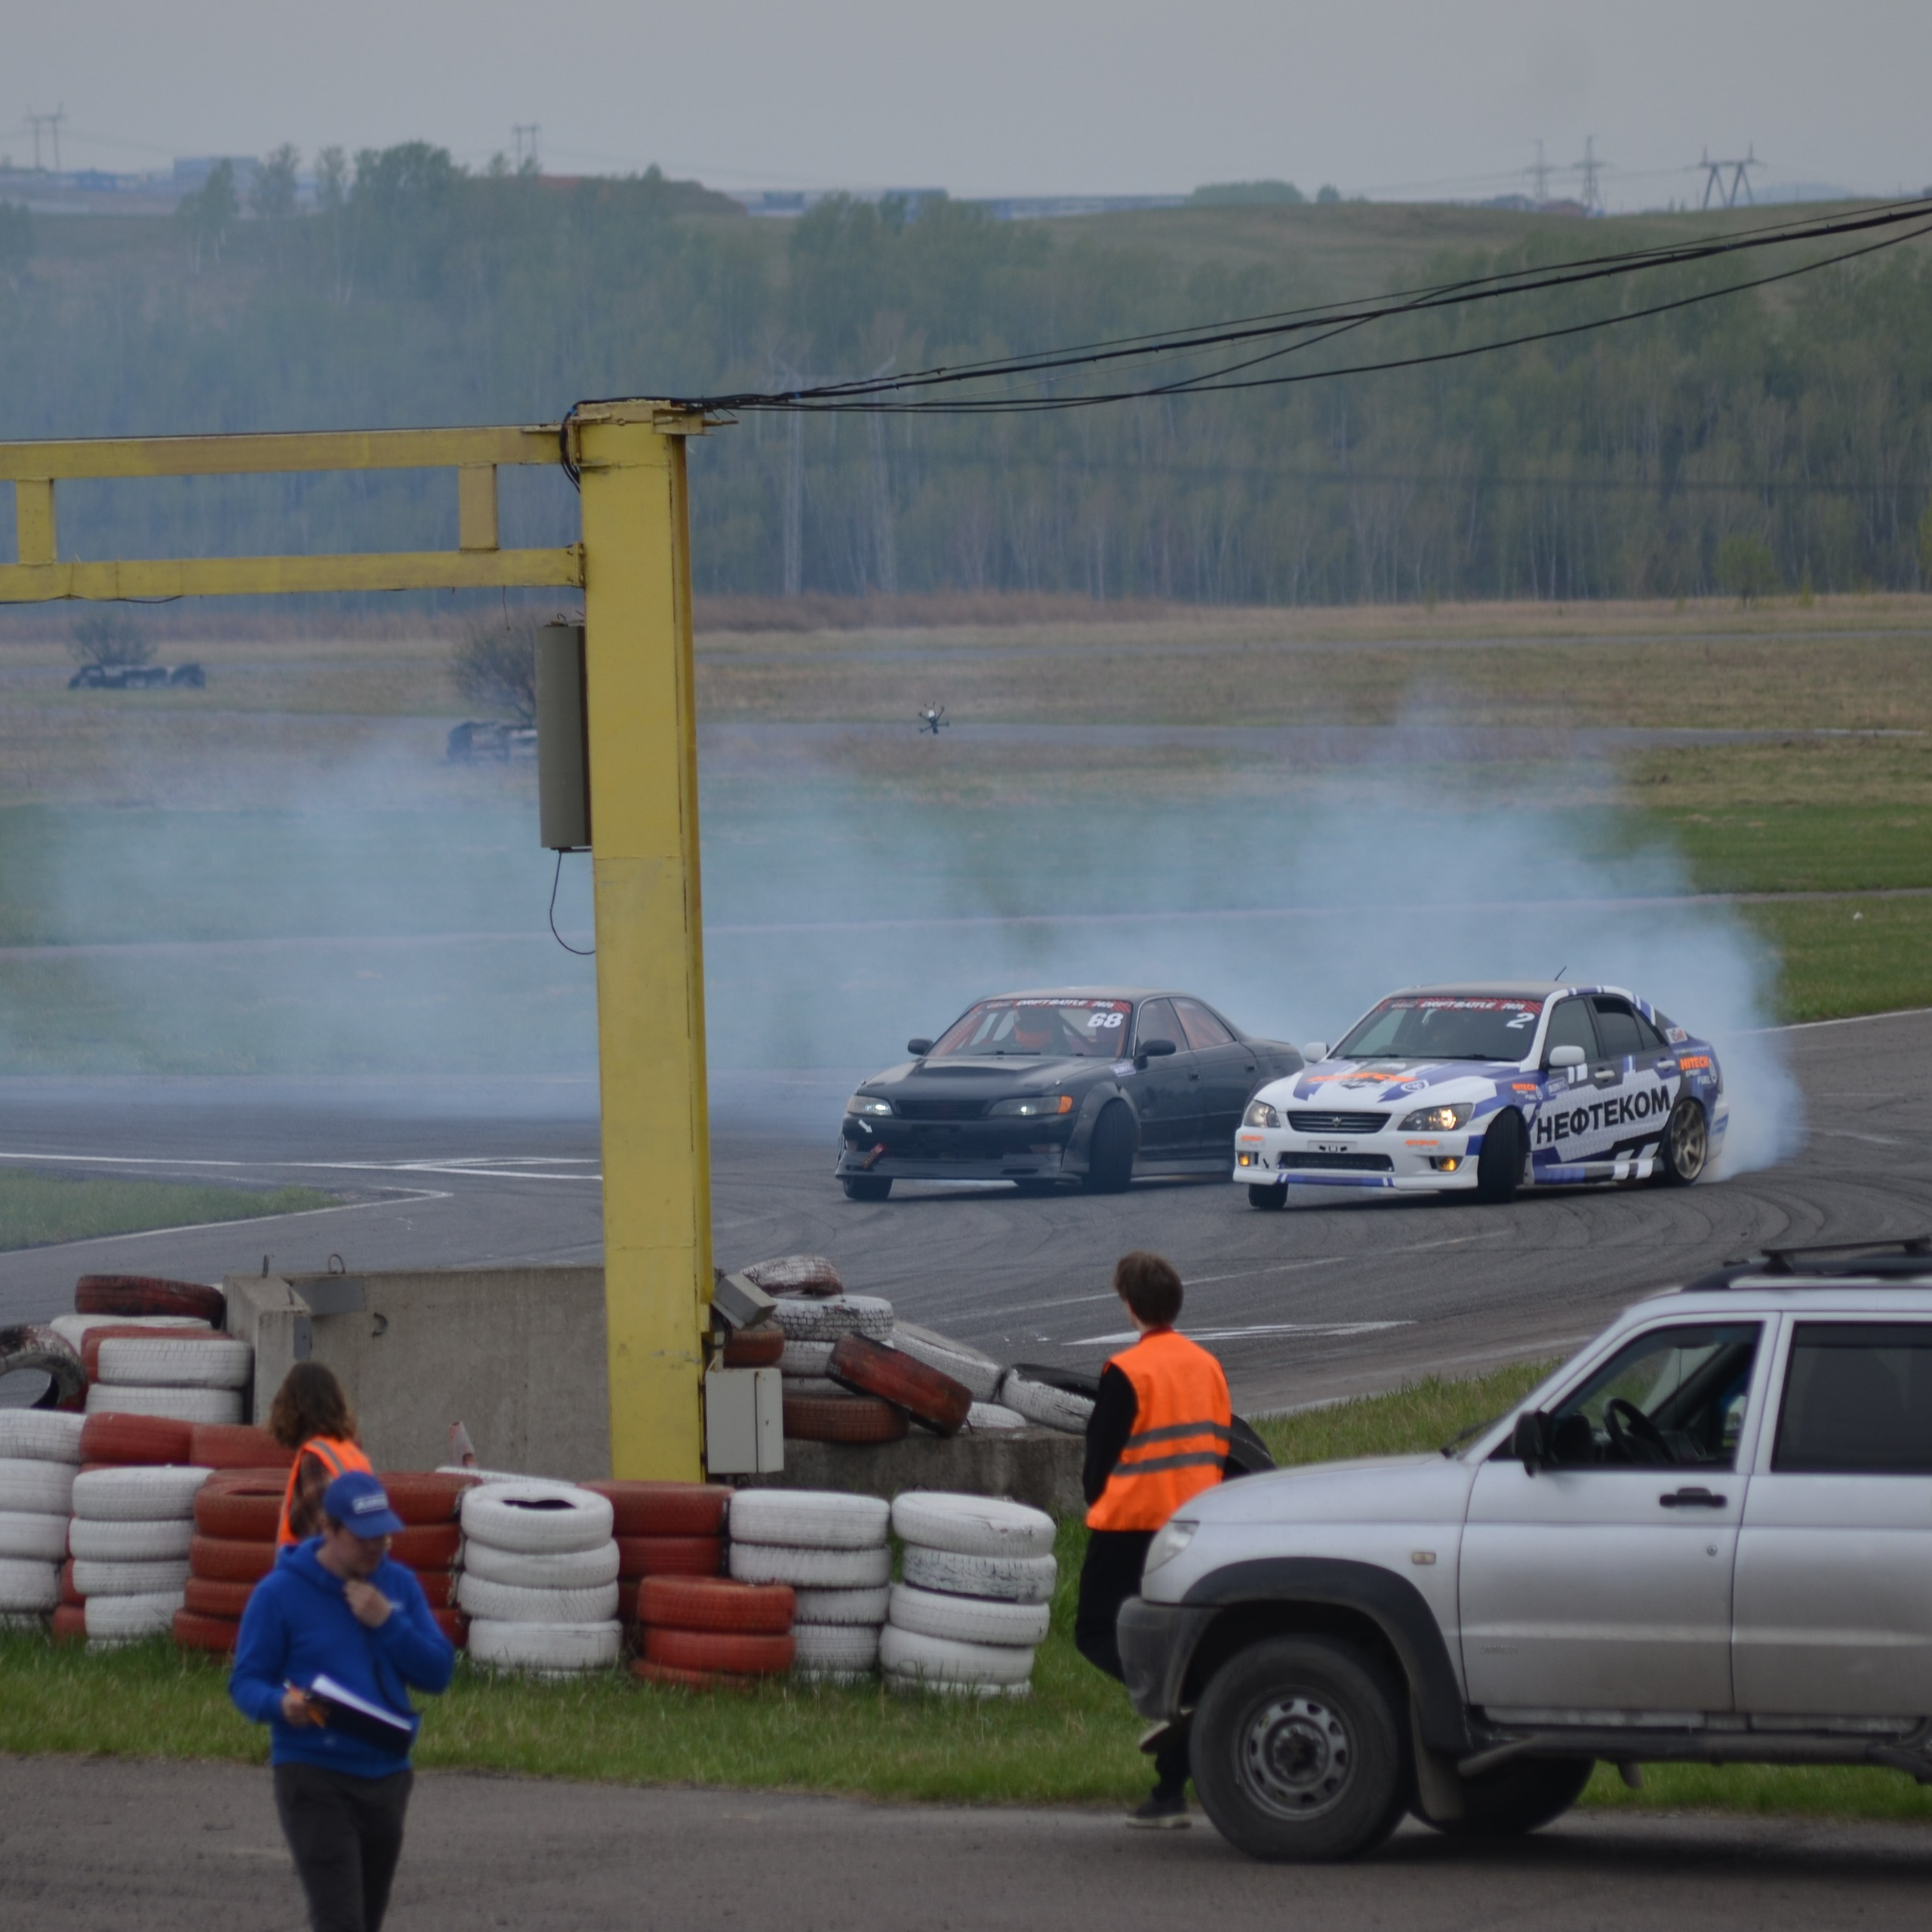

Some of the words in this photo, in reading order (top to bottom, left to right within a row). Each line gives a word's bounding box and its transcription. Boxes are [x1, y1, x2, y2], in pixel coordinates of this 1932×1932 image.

[1088, 1012, 1124, 1028] 68
[1506, 1012, 1535, 1029] 2
[1679, 1055, 1709, 1071] HITECH
[1512, 1082, 1536, 1091] HITECH
[1537, 1085, 1670, 1145] НЕФТЕКОМ
